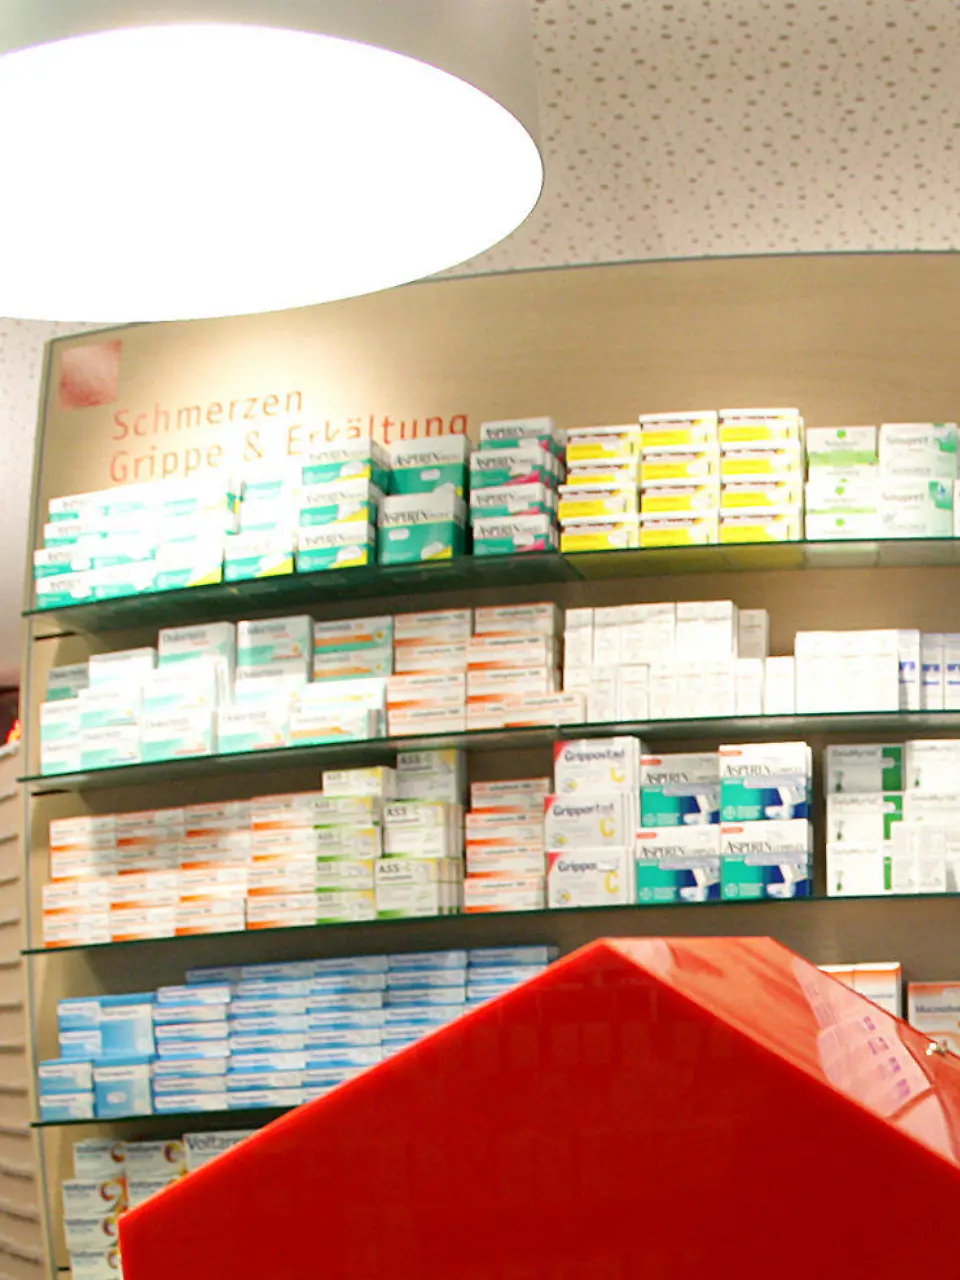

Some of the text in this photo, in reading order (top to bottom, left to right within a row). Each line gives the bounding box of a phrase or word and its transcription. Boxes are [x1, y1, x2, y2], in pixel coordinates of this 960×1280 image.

[111, 390, 303, 441] Schmerzen
[109, 444, 223, 483] Grippe
[243, 429, 262, 462] &
[600, 817, 615, 838] C
[604, 871, 620, 894] C
